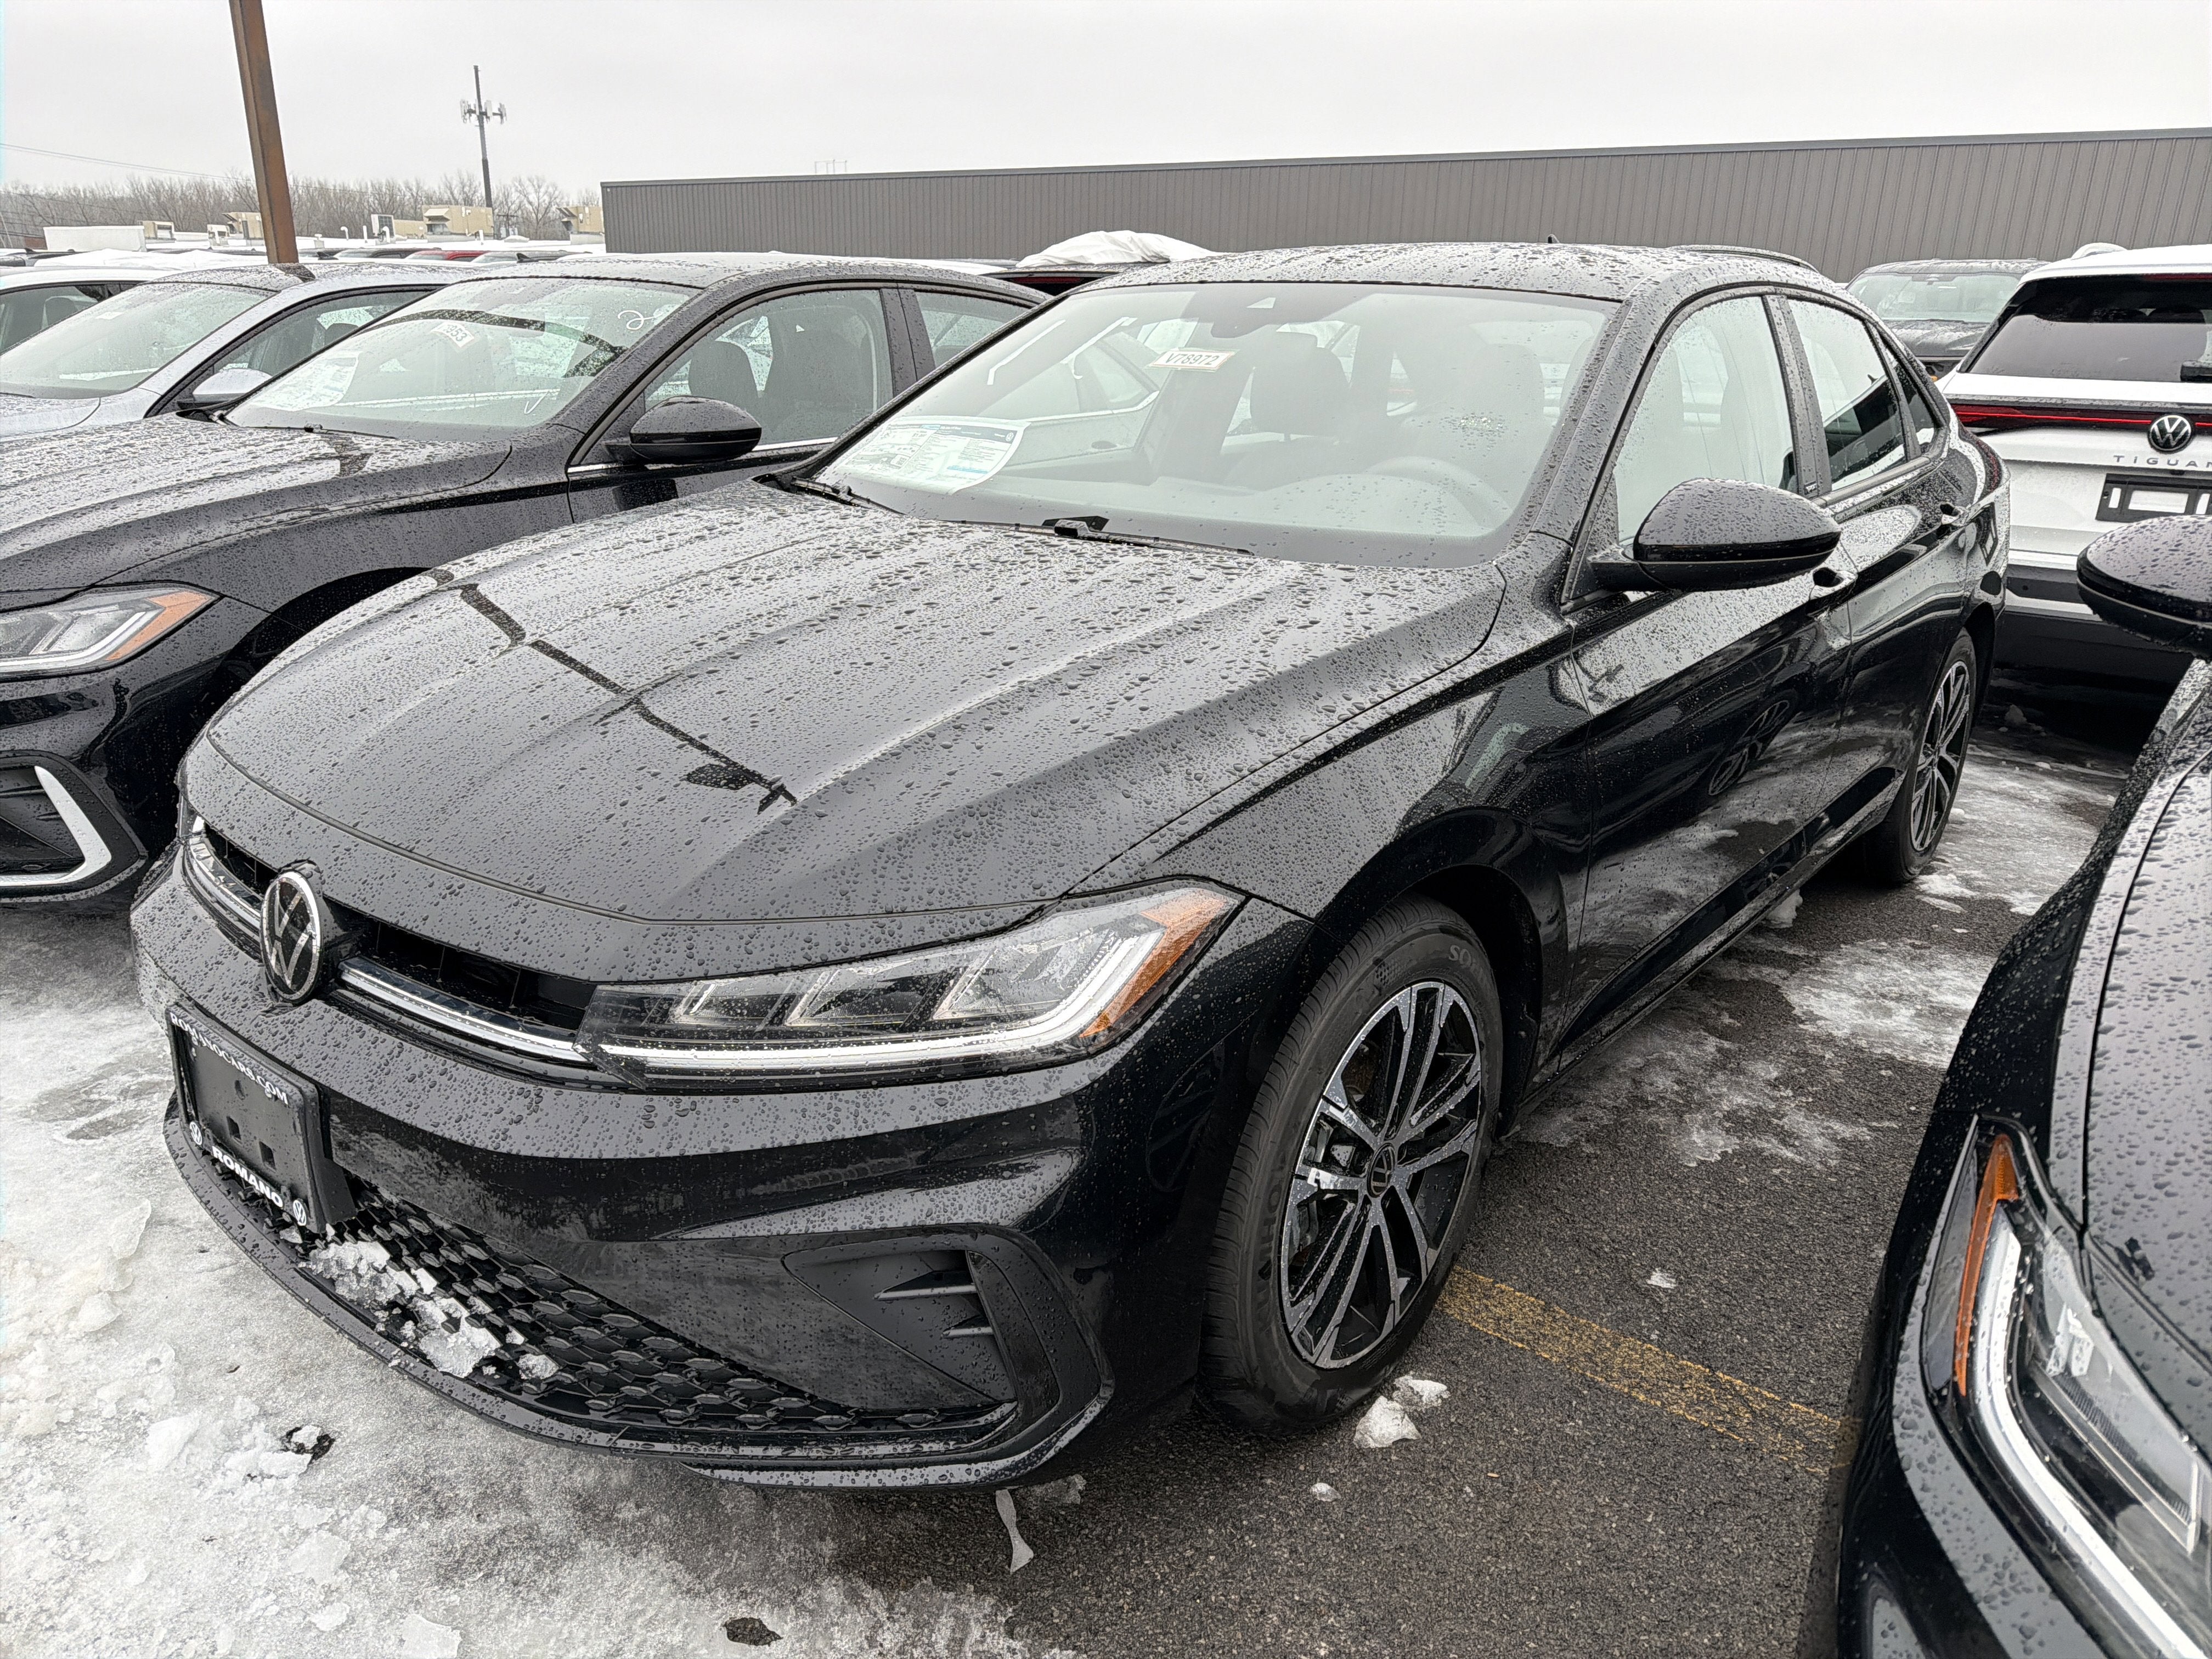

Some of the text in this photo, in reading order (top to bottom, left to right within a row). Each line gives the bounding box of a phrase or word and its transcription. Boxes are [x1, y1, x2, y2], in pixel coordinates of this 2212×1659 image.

[1165, 353, 1220, 365] V78972
[170, 1012, 289, 1105] ROMANOCARS.COM
[212, 1146, 283, 1207] ROMANO
